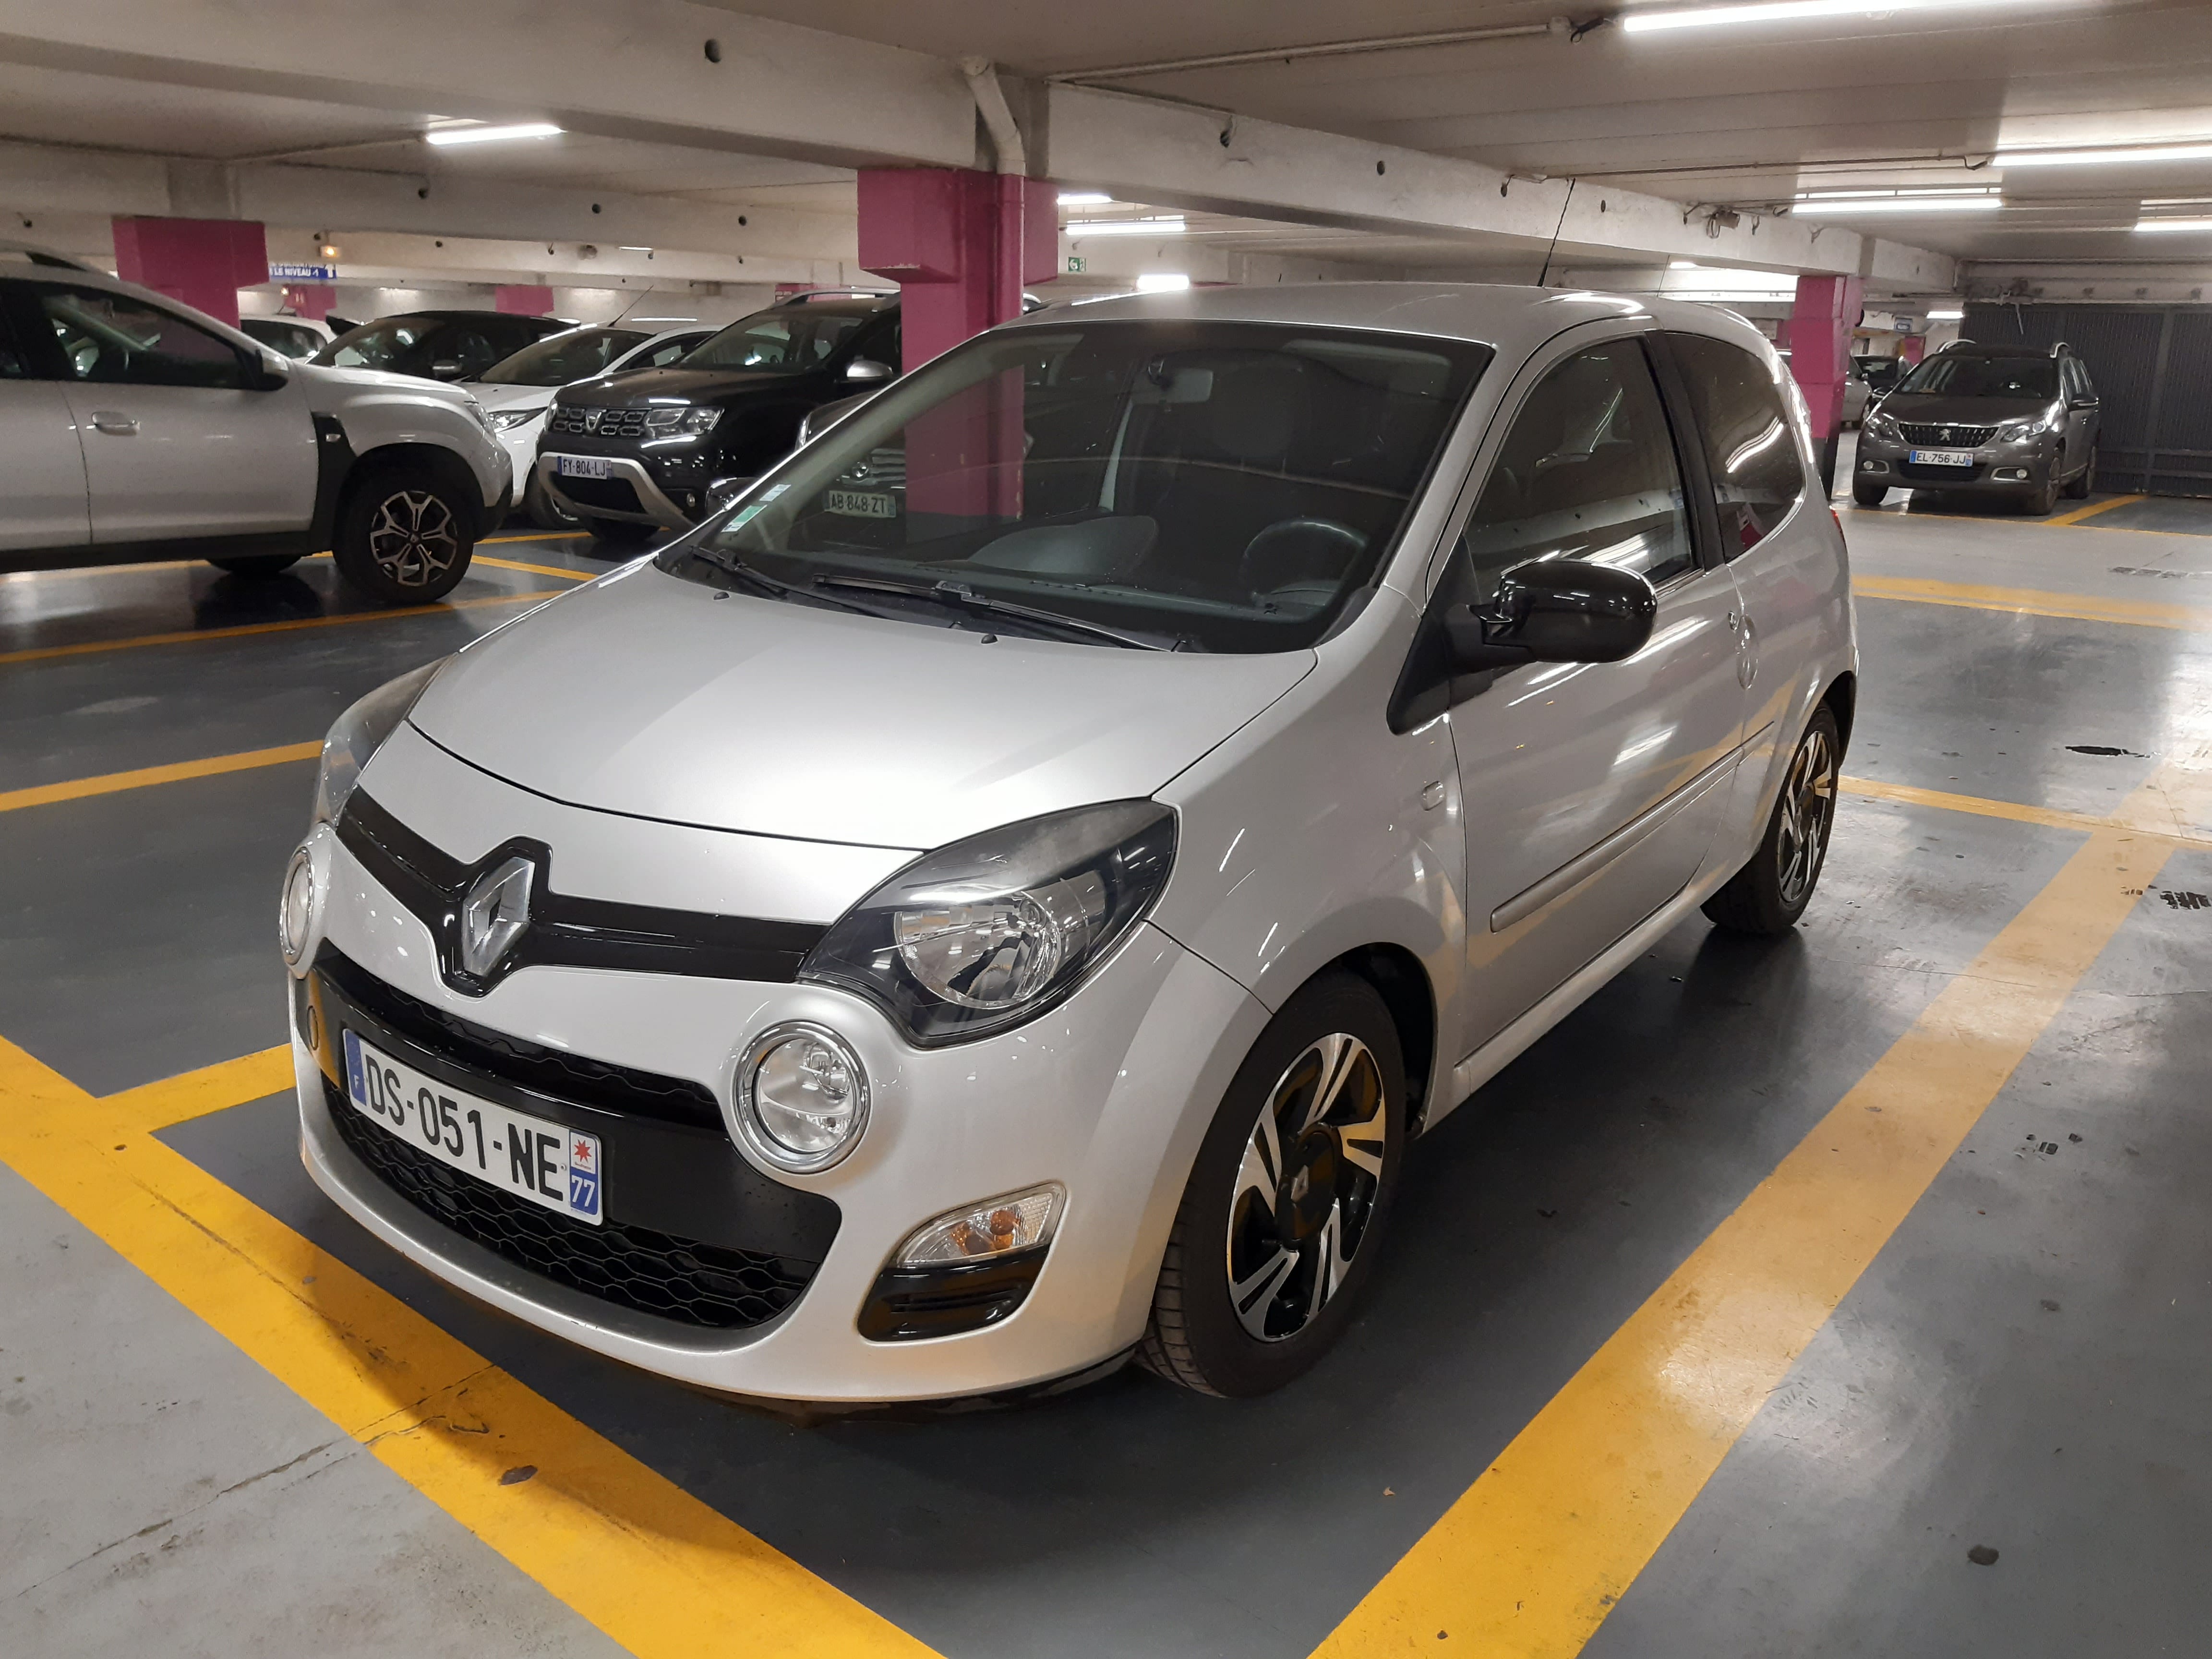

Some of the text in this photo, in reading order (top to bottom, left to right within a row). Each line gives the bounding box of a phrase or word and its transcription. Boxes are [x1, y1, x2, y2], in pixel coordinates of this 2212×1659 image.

[285, 267, 311, 276] NIVEAU
[563, 459, 605, 476] FY-804-LJ
[353, 1074, 359, 1089] F
[365, 1054, 563, 1202] DS-051-NE
[572, 1175, 596, 1207] 77
